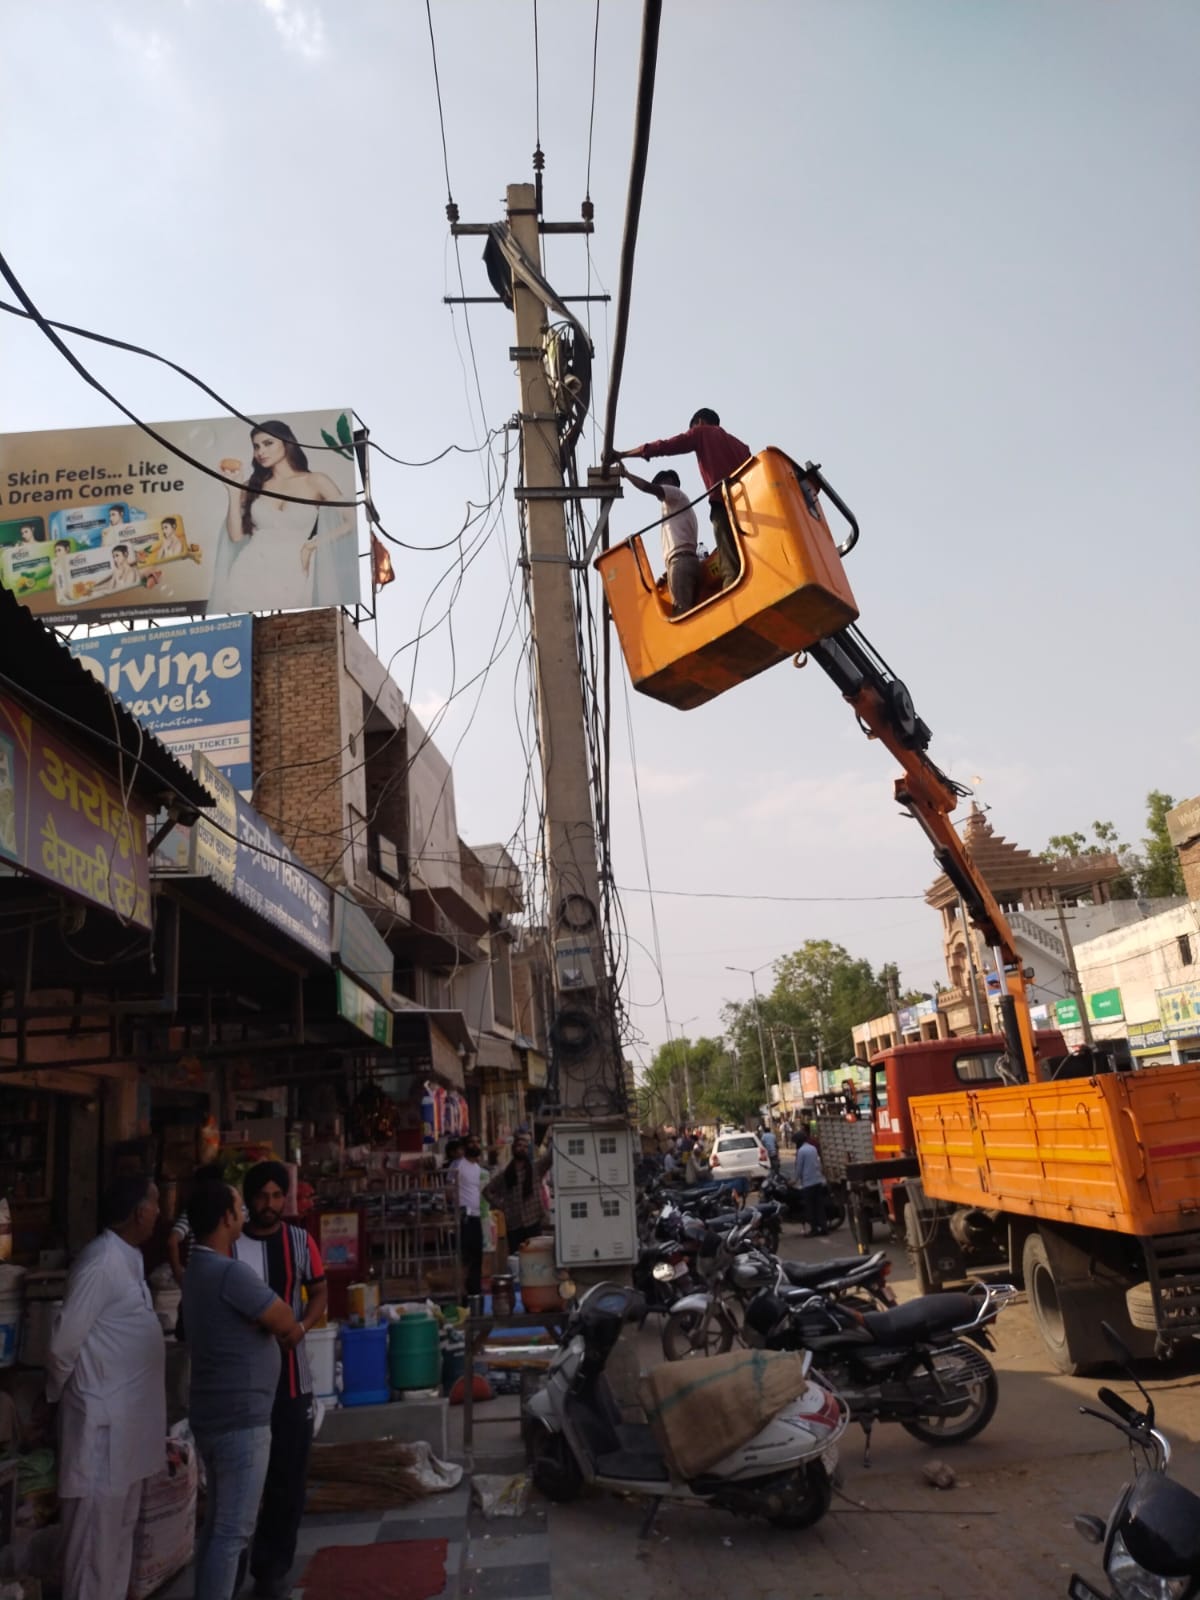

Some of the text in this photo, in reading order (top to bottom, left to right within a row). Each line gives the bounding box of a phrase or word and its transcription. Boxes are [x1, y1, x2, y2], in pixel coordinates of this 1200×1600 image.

[8, 461, 168, 487] Skin Feels... Like
[9, 487, 73, 505] Dream
[79, 482, 134, 499] Come
[139, 479, 185, 494] True
[199, 737, 240, 749] TICKETS
[40, 812, 110, 904] वैरायटी
